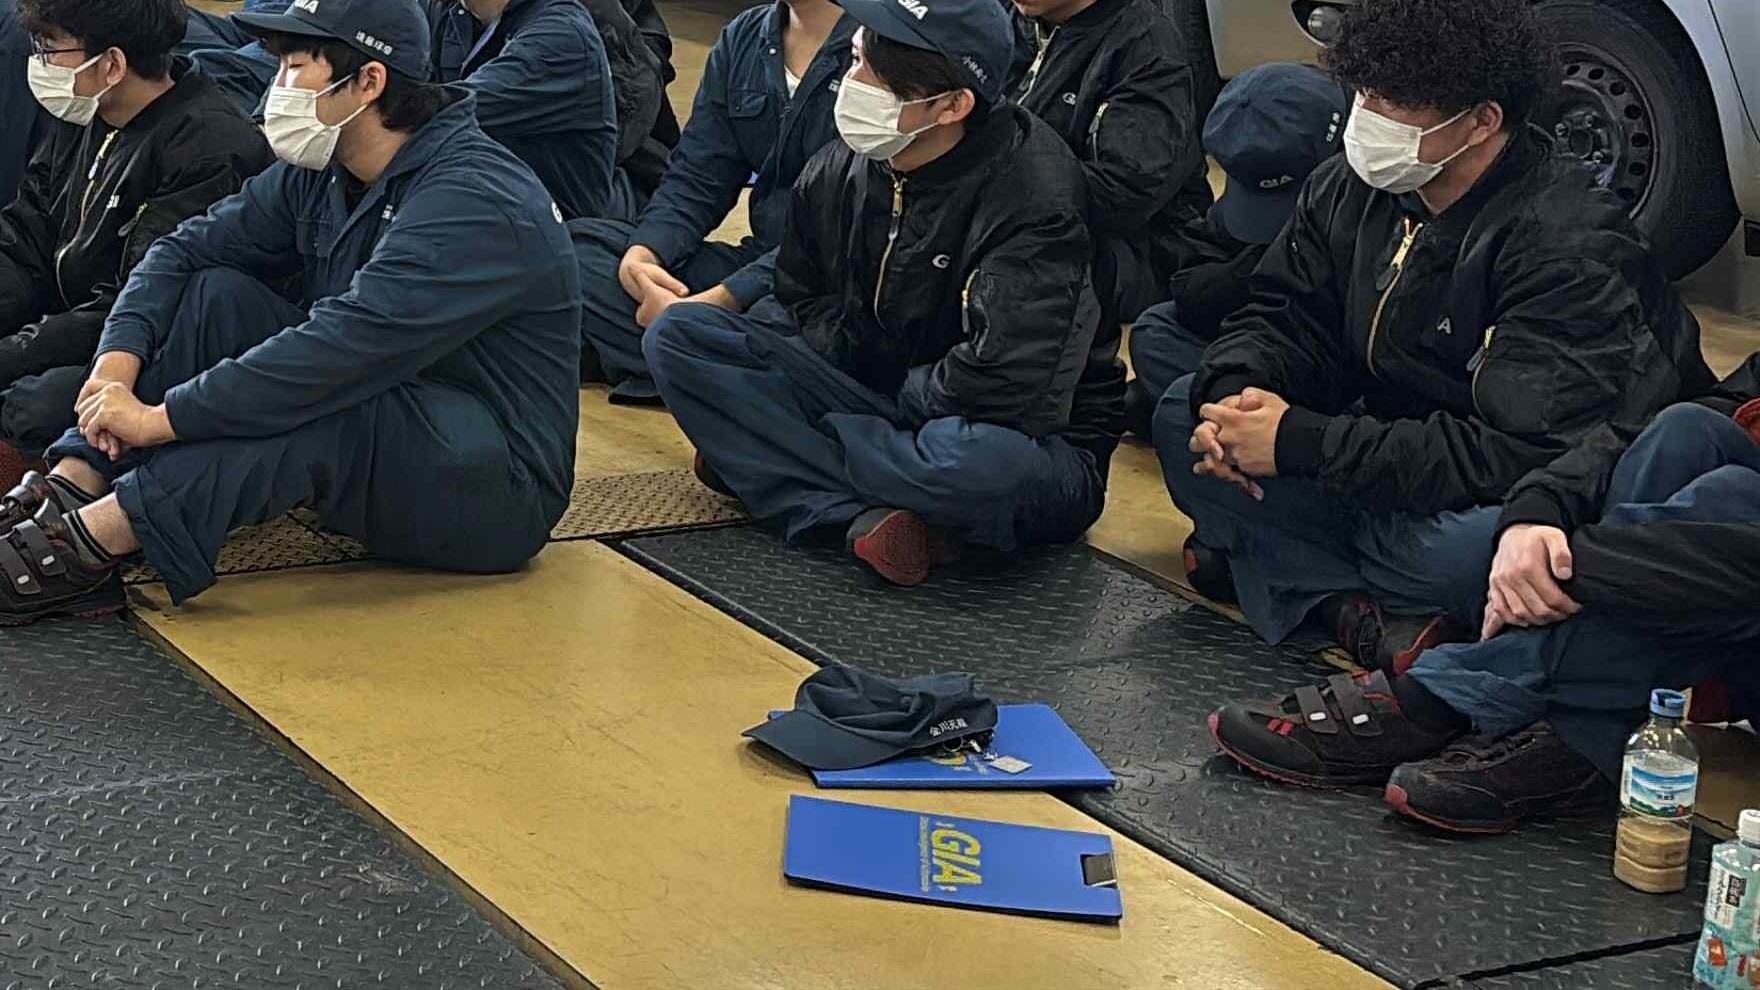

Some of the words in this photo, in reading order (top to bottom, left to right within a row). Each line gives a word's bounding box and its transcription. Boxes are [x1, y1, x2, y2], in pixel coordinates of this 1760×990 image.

[1259, 174, 1296, 188] GIA
[932, 253, 951, 269] G
[1436, 316, 1452, 335] A
[931, 828, 983, 886] GIA
